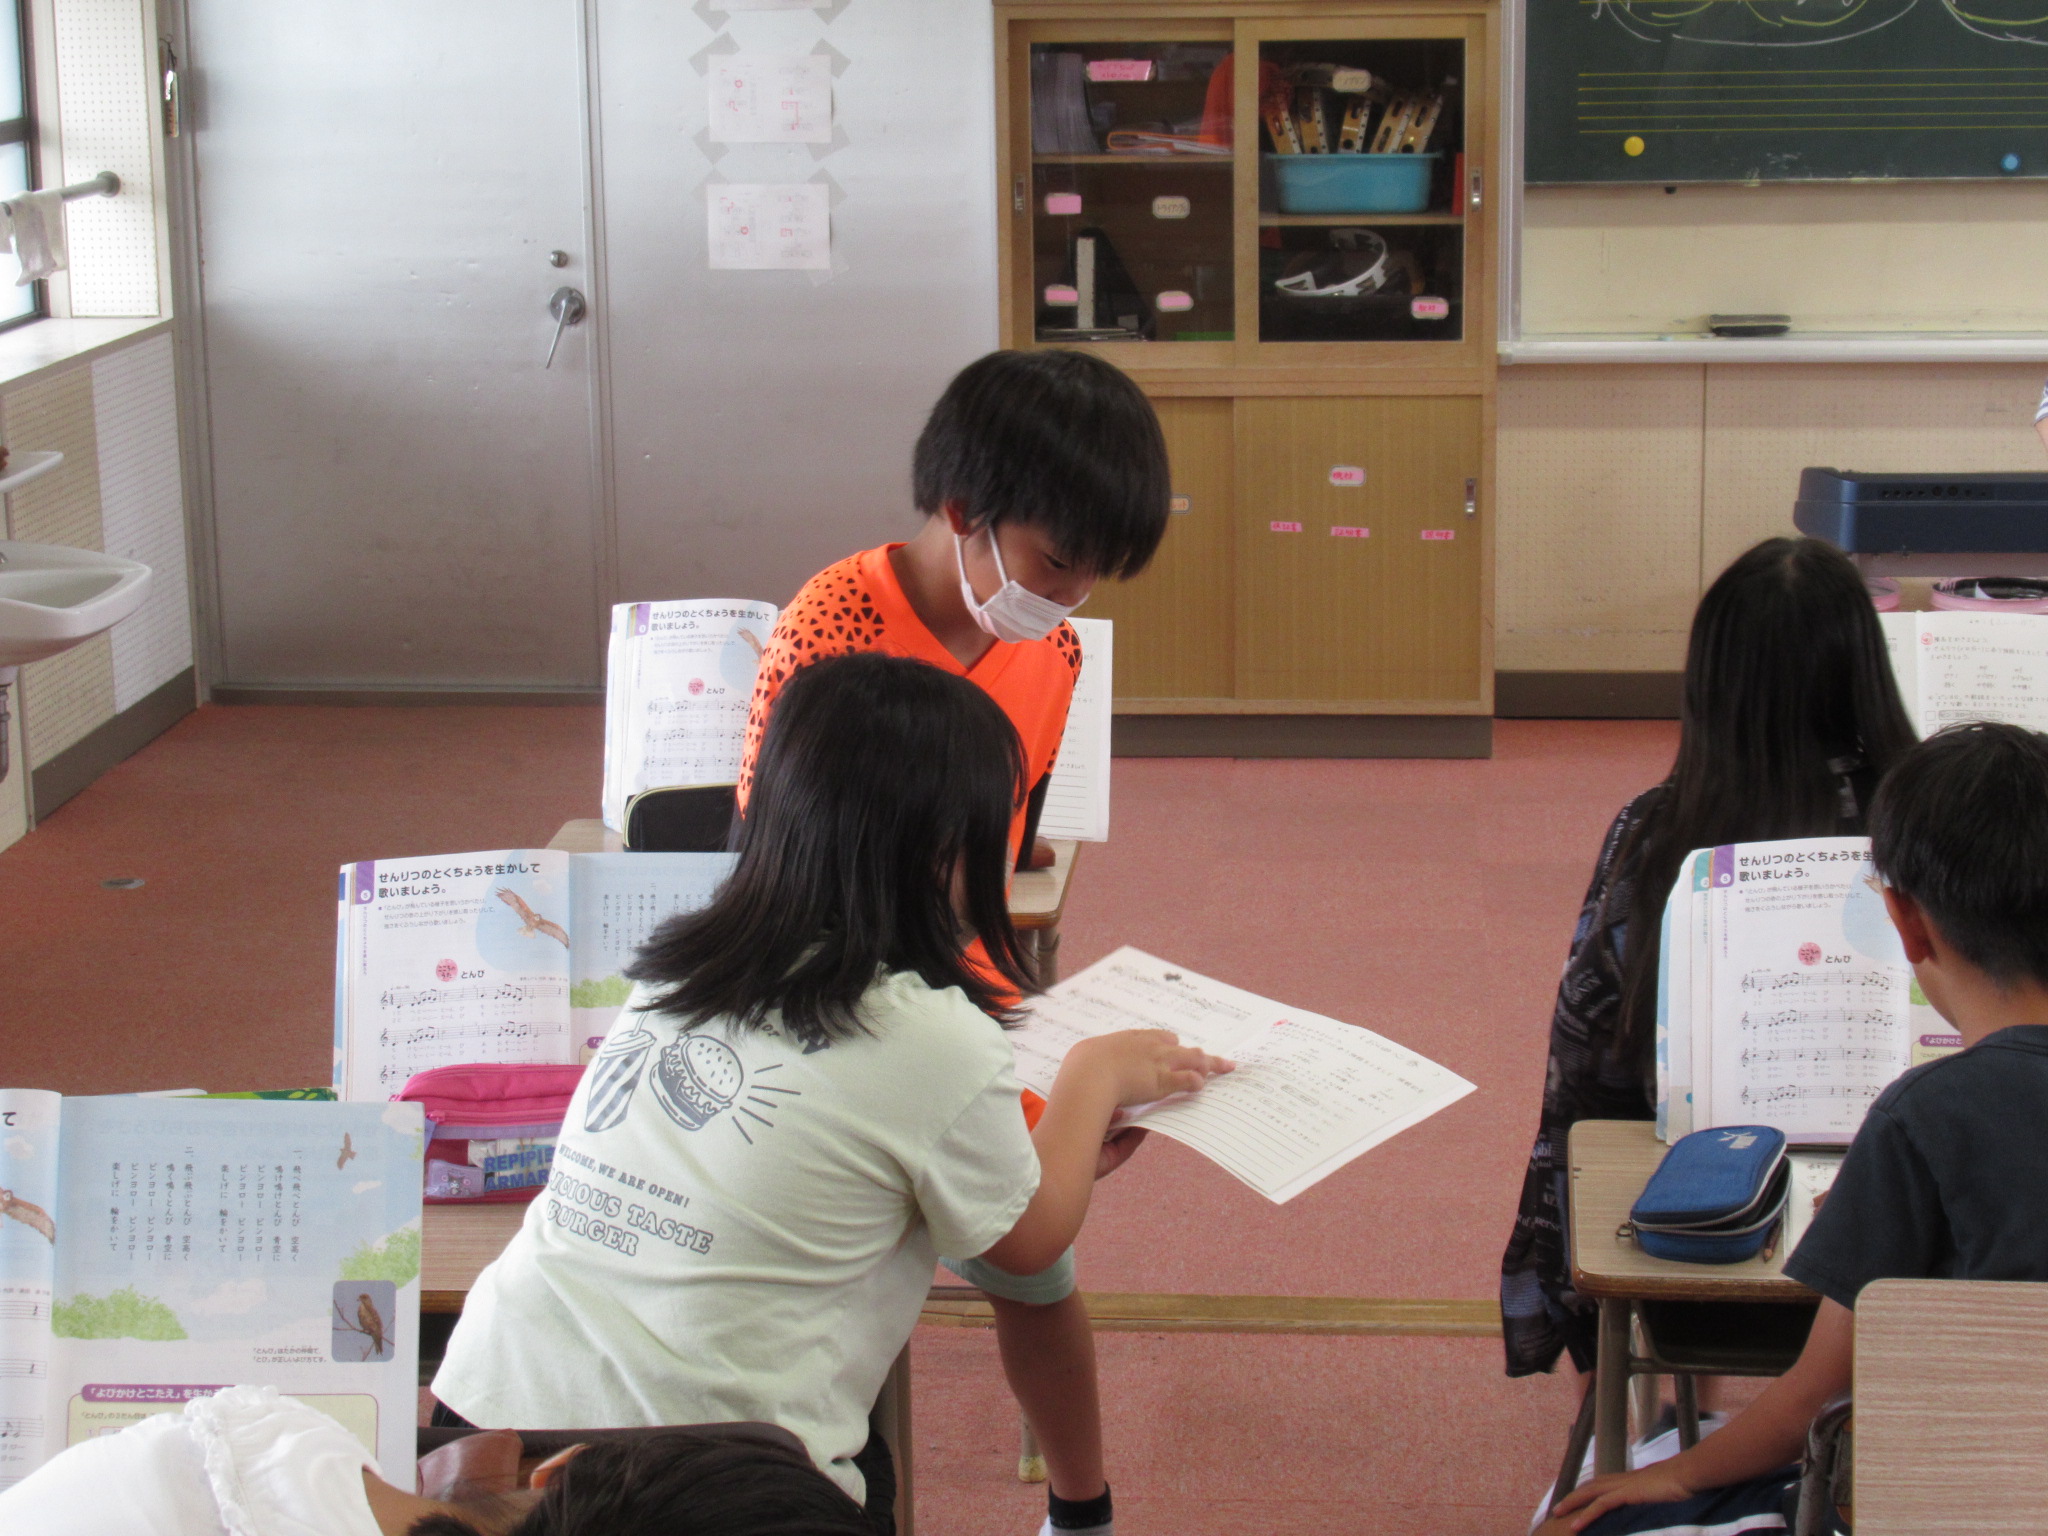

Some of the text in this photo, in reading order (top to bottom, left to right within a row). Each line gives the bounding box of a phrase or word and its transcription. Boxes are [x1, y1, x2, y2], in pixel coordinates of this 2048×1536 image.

[652, 608, 770, 622] せんりつのとくちょうを生かして
[379, 863, 541, 883] せんりつのとくちょうを生かして
[1739, 867, 1810, 882] 歌いましょう。
[378, 883, 447, 898] 歌いましょう。
[1825, 955, 1851, 964] とんび
[461, 970, 485, 979] とんび
[598, 1162, 617, 1179] WE
[618, 1172, 646, 1191] ARE
[648, 1183, 690, 1208] OPEN!
[547, 1199, 639, 1256] BURGER
[627, 1203, 714, 1255] TASTE
